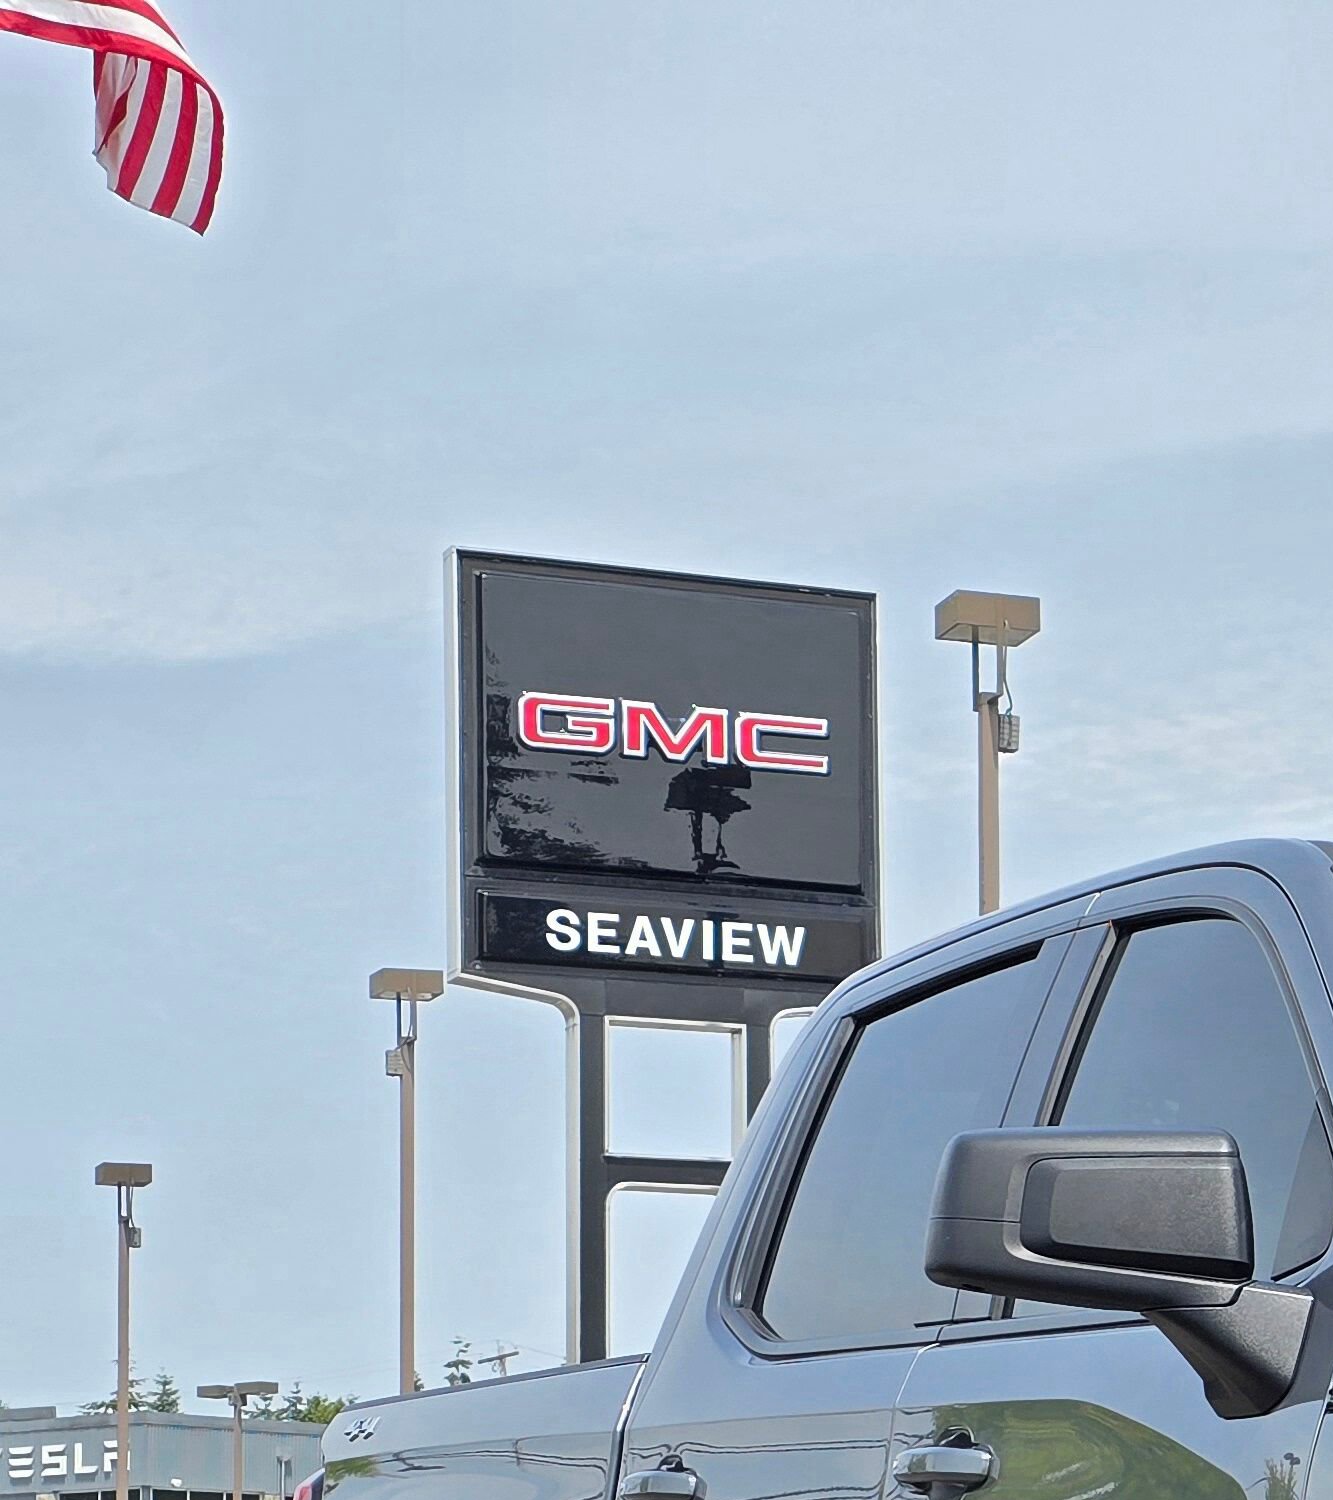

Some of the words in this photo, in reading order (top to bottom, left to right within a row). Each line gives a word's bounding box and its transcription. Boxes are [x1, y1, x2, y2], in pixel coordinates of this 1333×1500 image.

[518, 691, 829, 774] GMC
[545, 909, 805, 966] SEAVIEW
[0, 1440, 131, 1478] ESLA
